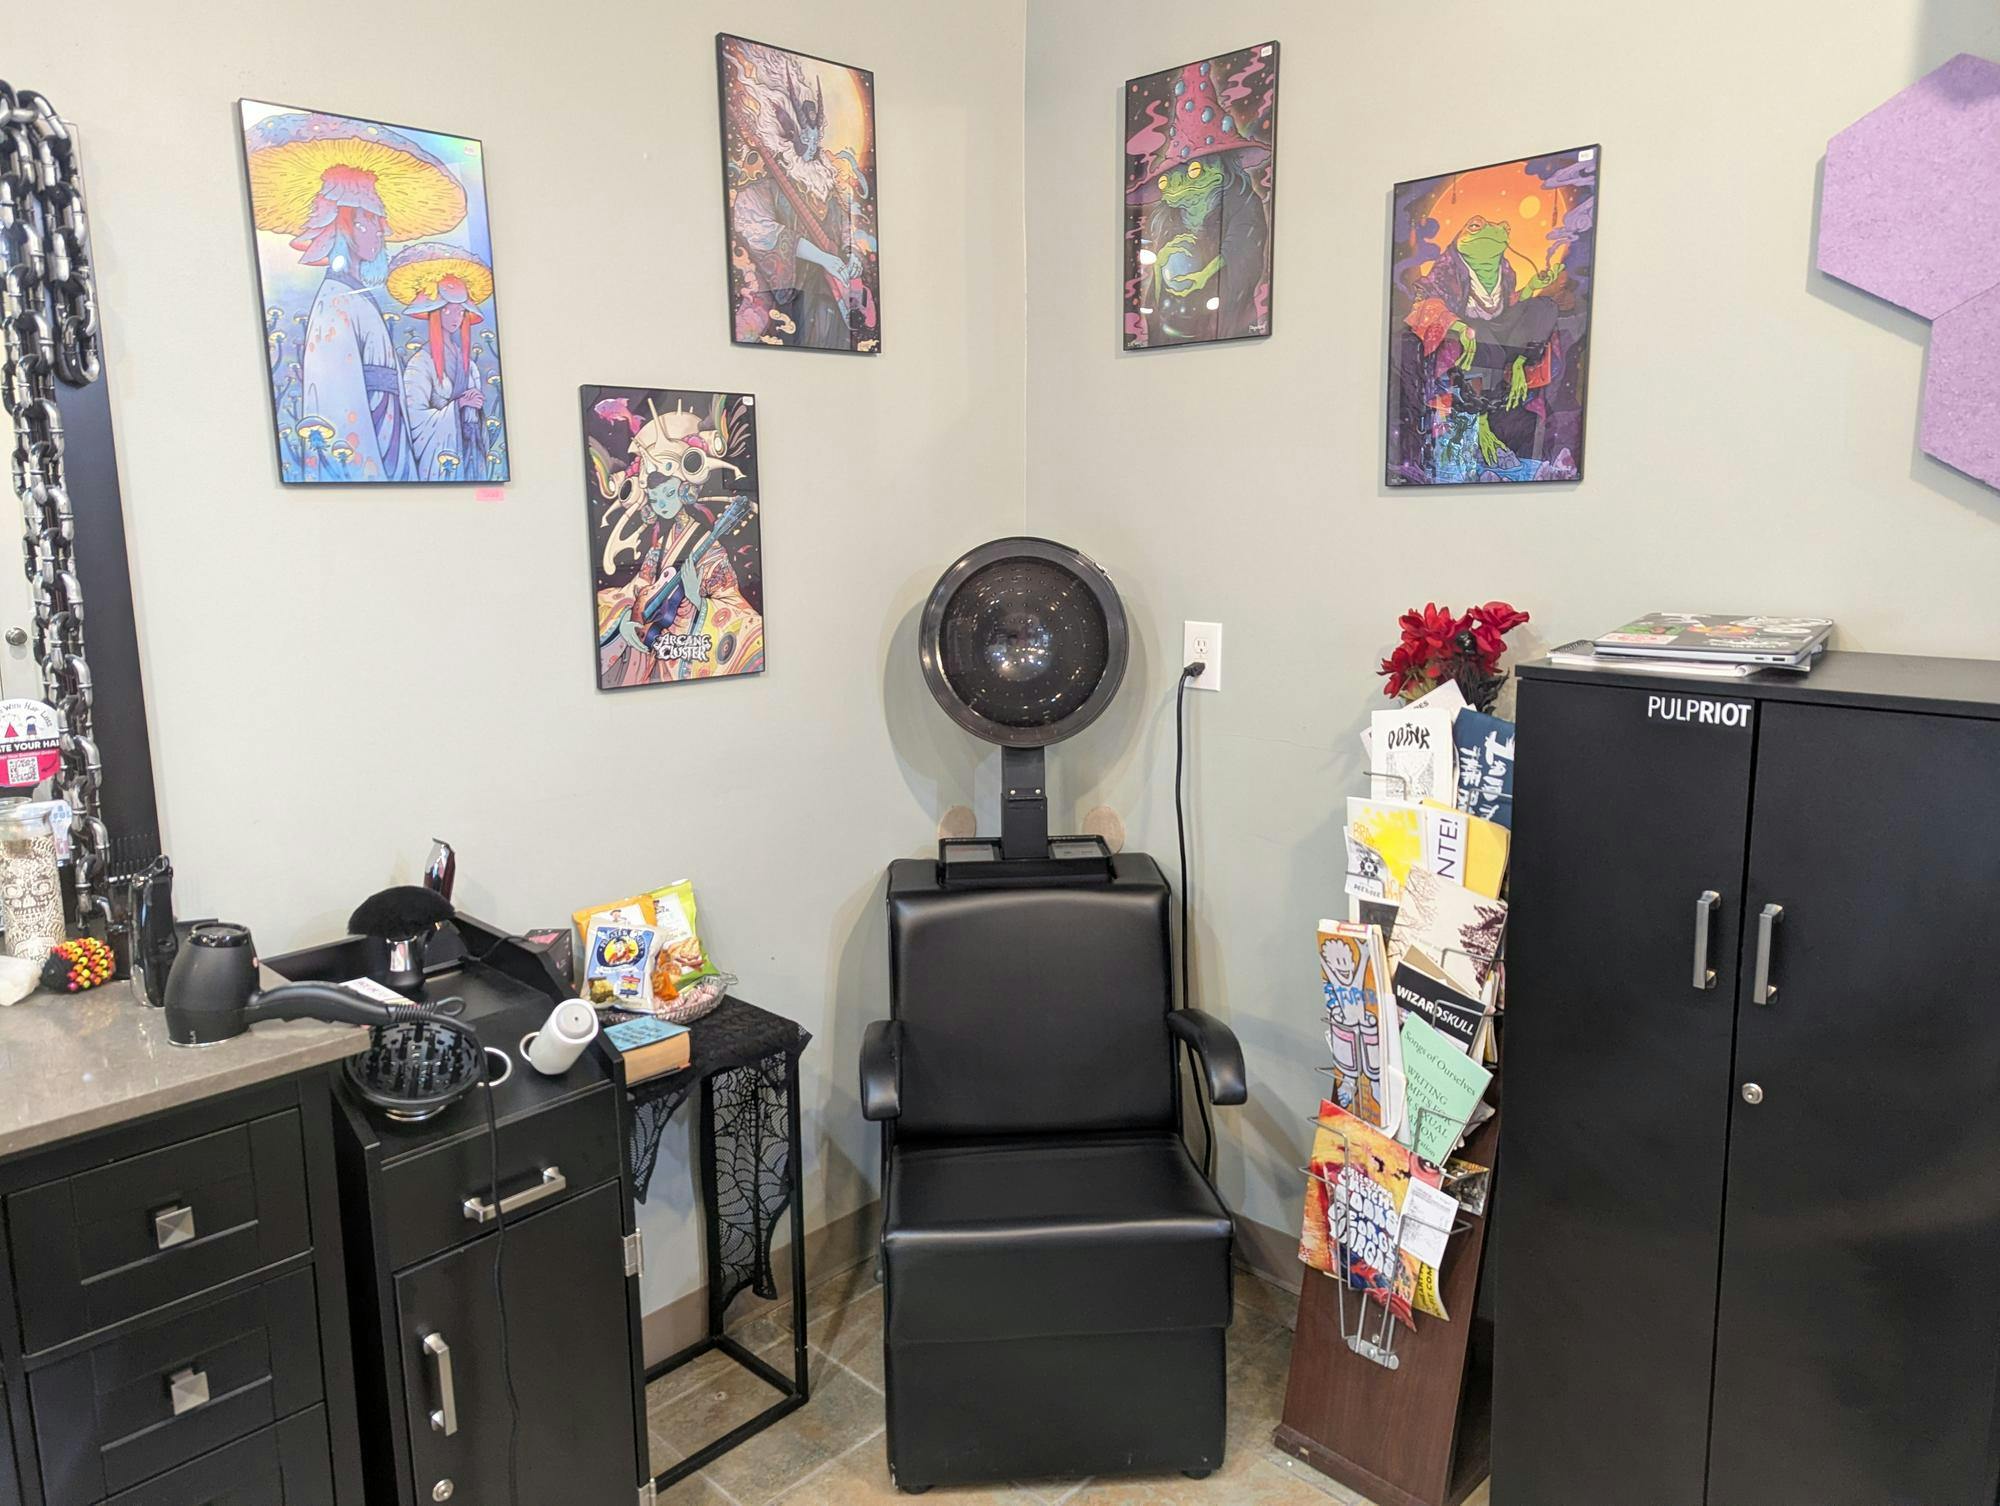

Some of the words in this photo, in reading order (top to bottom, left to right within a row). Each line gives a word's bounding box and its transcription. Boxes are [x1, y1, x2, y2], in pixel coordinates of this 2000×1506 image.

[653, 633, 712, 650] ARCANE
[655, 644, 709, 662] CLUSTER
[1648, 695, 1752, 728] PULPRIOT
[0, 743, 12, 754] TE
[14, 740, 41, 752] YOUR
[43, 738, 60, 749] HAI
[1405, 1030, 1426, 1057] Songs
[1426, 1052, 1438, 1063] of
[1437, 1059, 1475, 1097] Ourselves
[1407, 1064, 1449, 1107] WRITING
[1412, 1100, 1449, 1139] SXUAL
